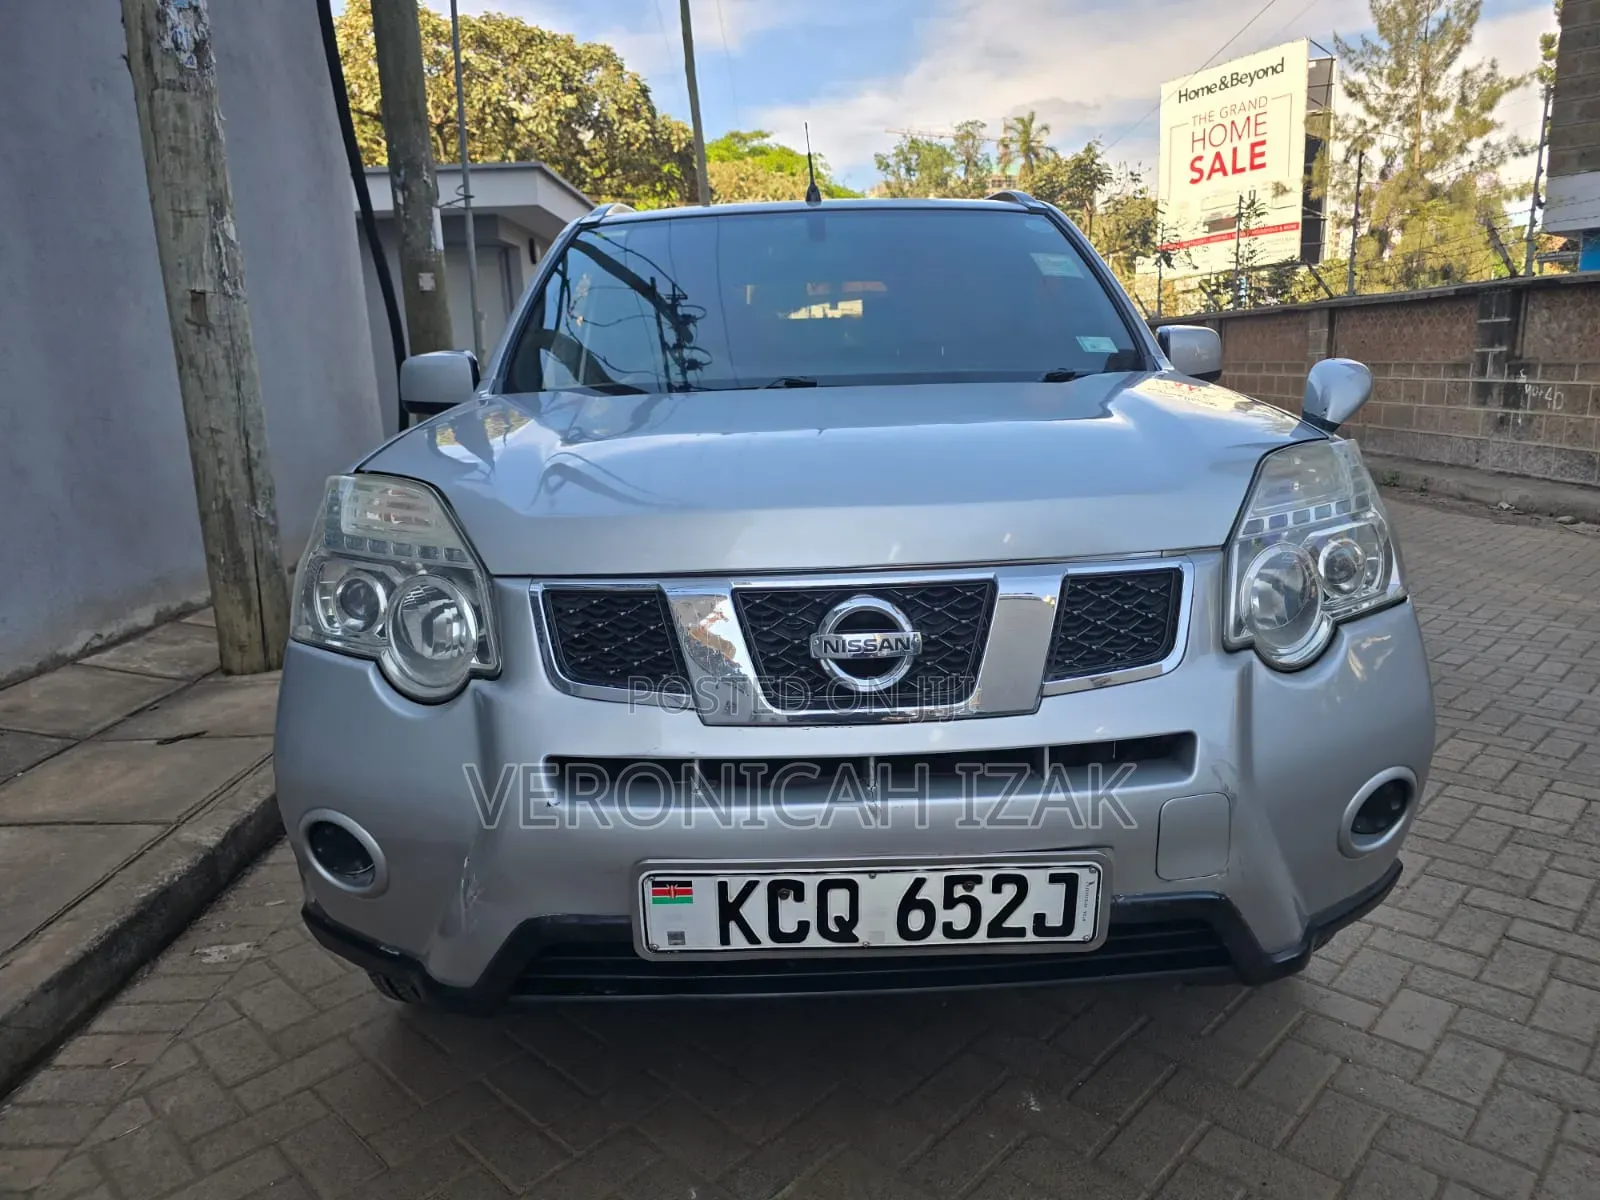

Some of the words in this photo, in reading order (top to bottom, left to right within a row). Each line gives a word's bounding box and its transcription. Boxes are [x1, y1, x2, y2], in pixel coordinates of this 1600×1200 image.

[1178, 57, 1284, 103] Home&Beyond
[1191, 112, 1267, 153] HOME
[1192, 111, 1215, 126] THE
[1219, 96, 1268, 118] GRAND
[1189, 140, 1267, 185] SALE
[823, 638, 910, 653] NISSAN
[717, 876, 860, 946] KCQ
[896, 872, 1080, 941] 652J
